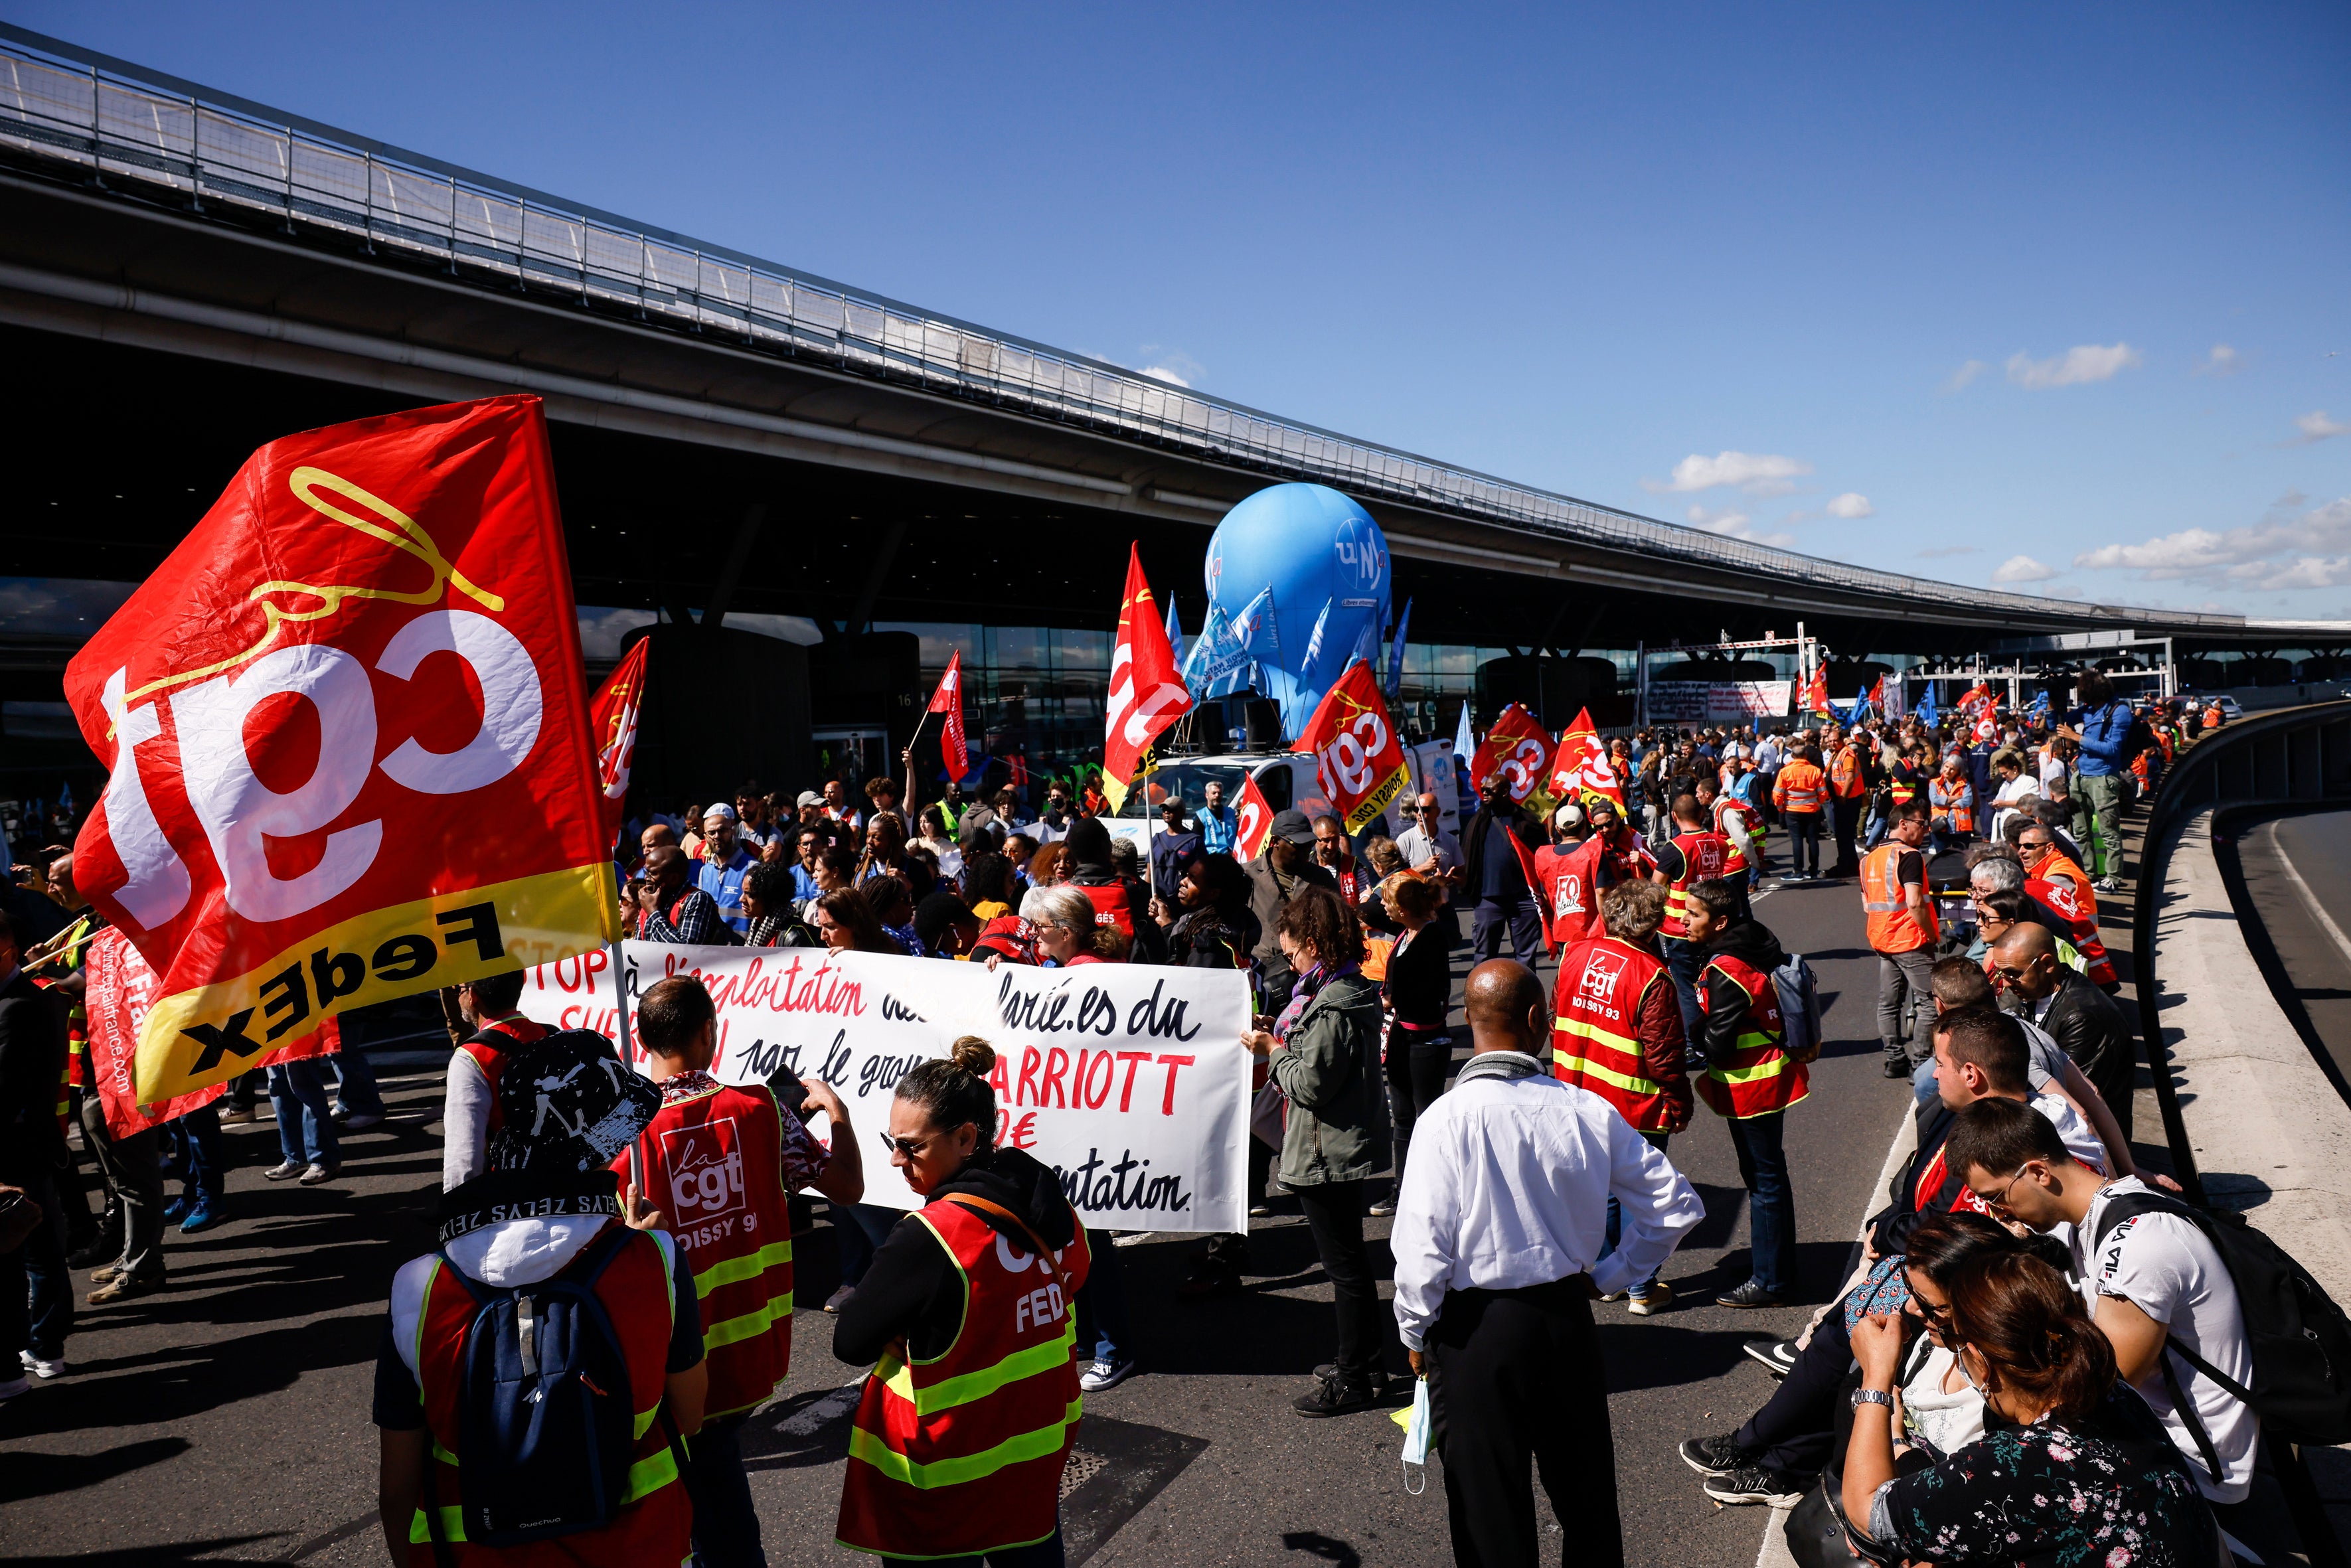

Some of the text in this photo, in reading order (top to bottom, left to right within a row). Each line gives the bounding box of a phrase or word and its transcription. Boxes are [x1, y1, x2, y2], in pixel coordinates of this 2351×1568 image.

[898, 694, 911, 707] 16
[1702, 850, 1720, 869] cgt
[1095, 911, 1115, 923] GÉS
[122, 940, 147, 969] ir
[1582, 969, 1618, 997] cgt
[1127, 979, 1202, 1042] du
[1605, 1007, 1620, 1020] 93
[817, 1028, 852, 1088] le
[981, 1045, 1196, 1117] ARRIOTT
[672, 1151, 743, 1211] cgt
[491, 1198, 567, 1223] ZELYS
[1963, 1188, 1988, 1215] cg
[675, 1217, 735, 1253] OISSY
[519, 1517, 561, 1529] Quechua
